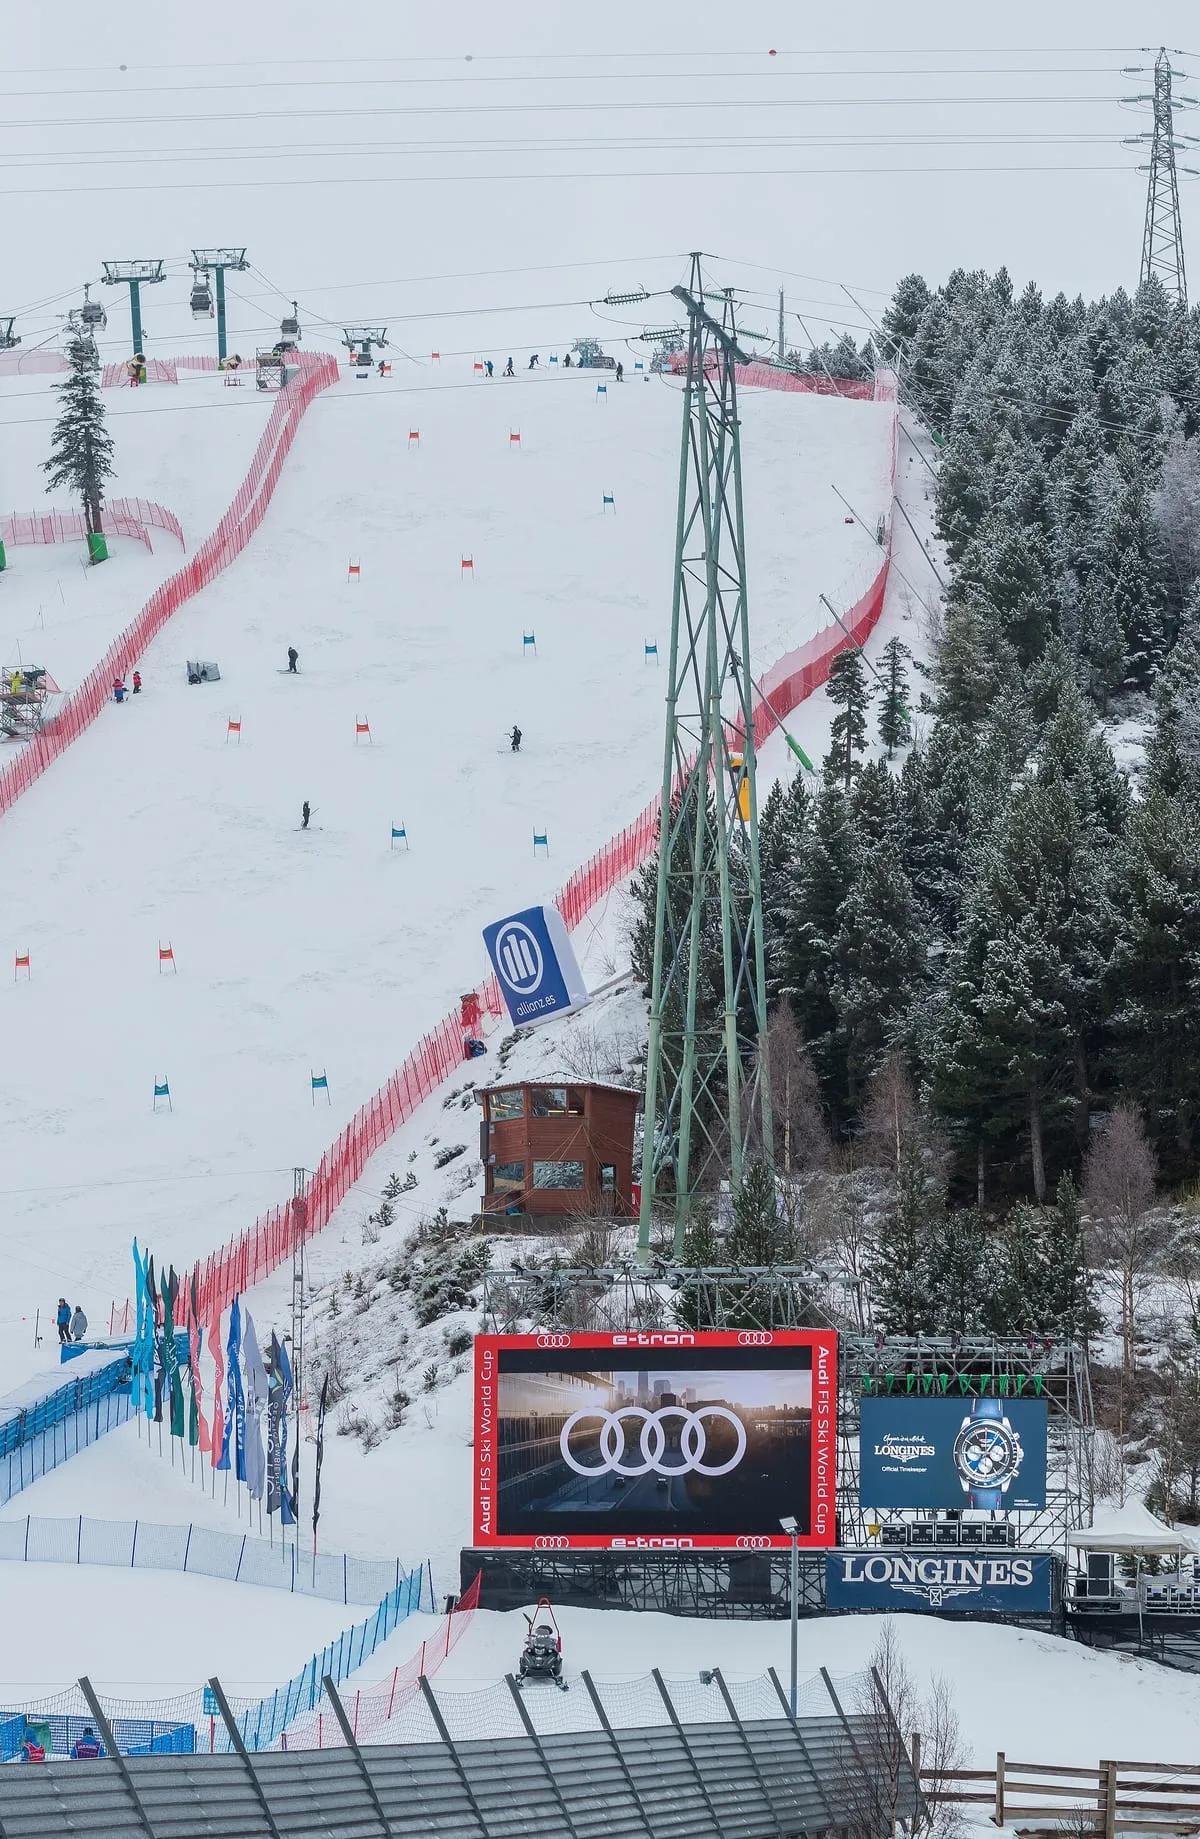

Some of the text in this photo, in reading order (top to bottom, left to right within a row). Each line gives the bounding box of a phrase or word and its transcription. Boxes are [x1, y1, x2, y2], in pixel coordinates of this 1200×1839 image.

[517, 995, 556, 1016] allianz.es
[612, 1334, 695, 1345] e-tron
[479, 1350, 494, 1534] Audi FIS Ski World Cup
[815, 1345, 829, 1534] Audi FIS Ski World Cup
[874, 1445, 935, 1456] LONGINES
[611, 1536, 693, 1548] e-tron
[841, 1557, 1033, 1586] LONGINES
